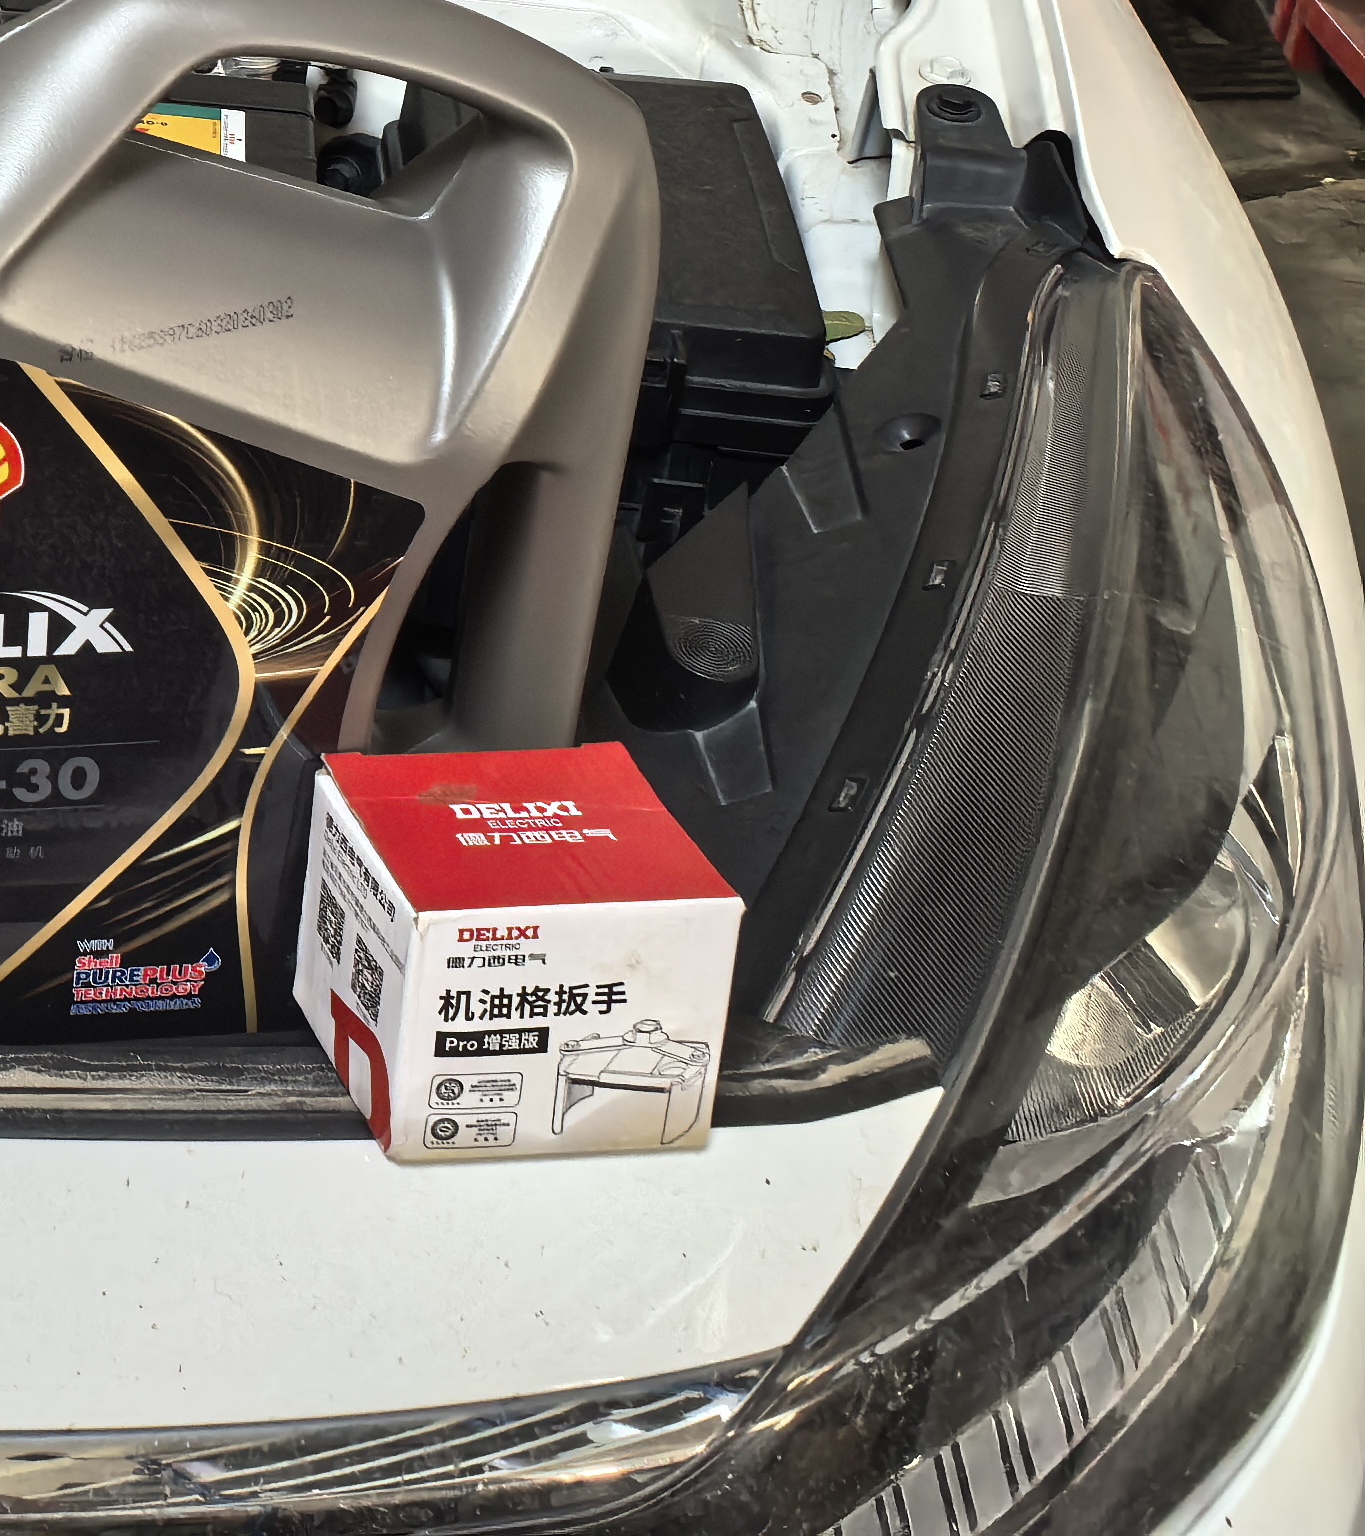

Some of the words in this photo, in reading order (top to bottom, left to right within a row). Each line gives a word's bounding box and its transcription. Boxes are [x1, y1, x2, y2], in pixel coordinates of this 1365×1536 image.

[449, 800, 583, 820] DELIXI
[486, 818, 563, 829] ELECTRIC
[455, 828, 618, 846] 德力西电气
[456, 925, 540, 943] DELIXI
[473, 942, 521, 952] ELECTRIC
[75, 953, 121, 970] Shell
[446, 952, 547, 969] 德力西电气
[73, 962, 207, 987] PUREPLUS
[73, 981, 205, 1002] TECHNOLOGY
[437, 981, 628, 1023] 机油格扳手
[445, 1036, 477, 1052] Pro
[482, 1033, 539, 1051] 增强版
